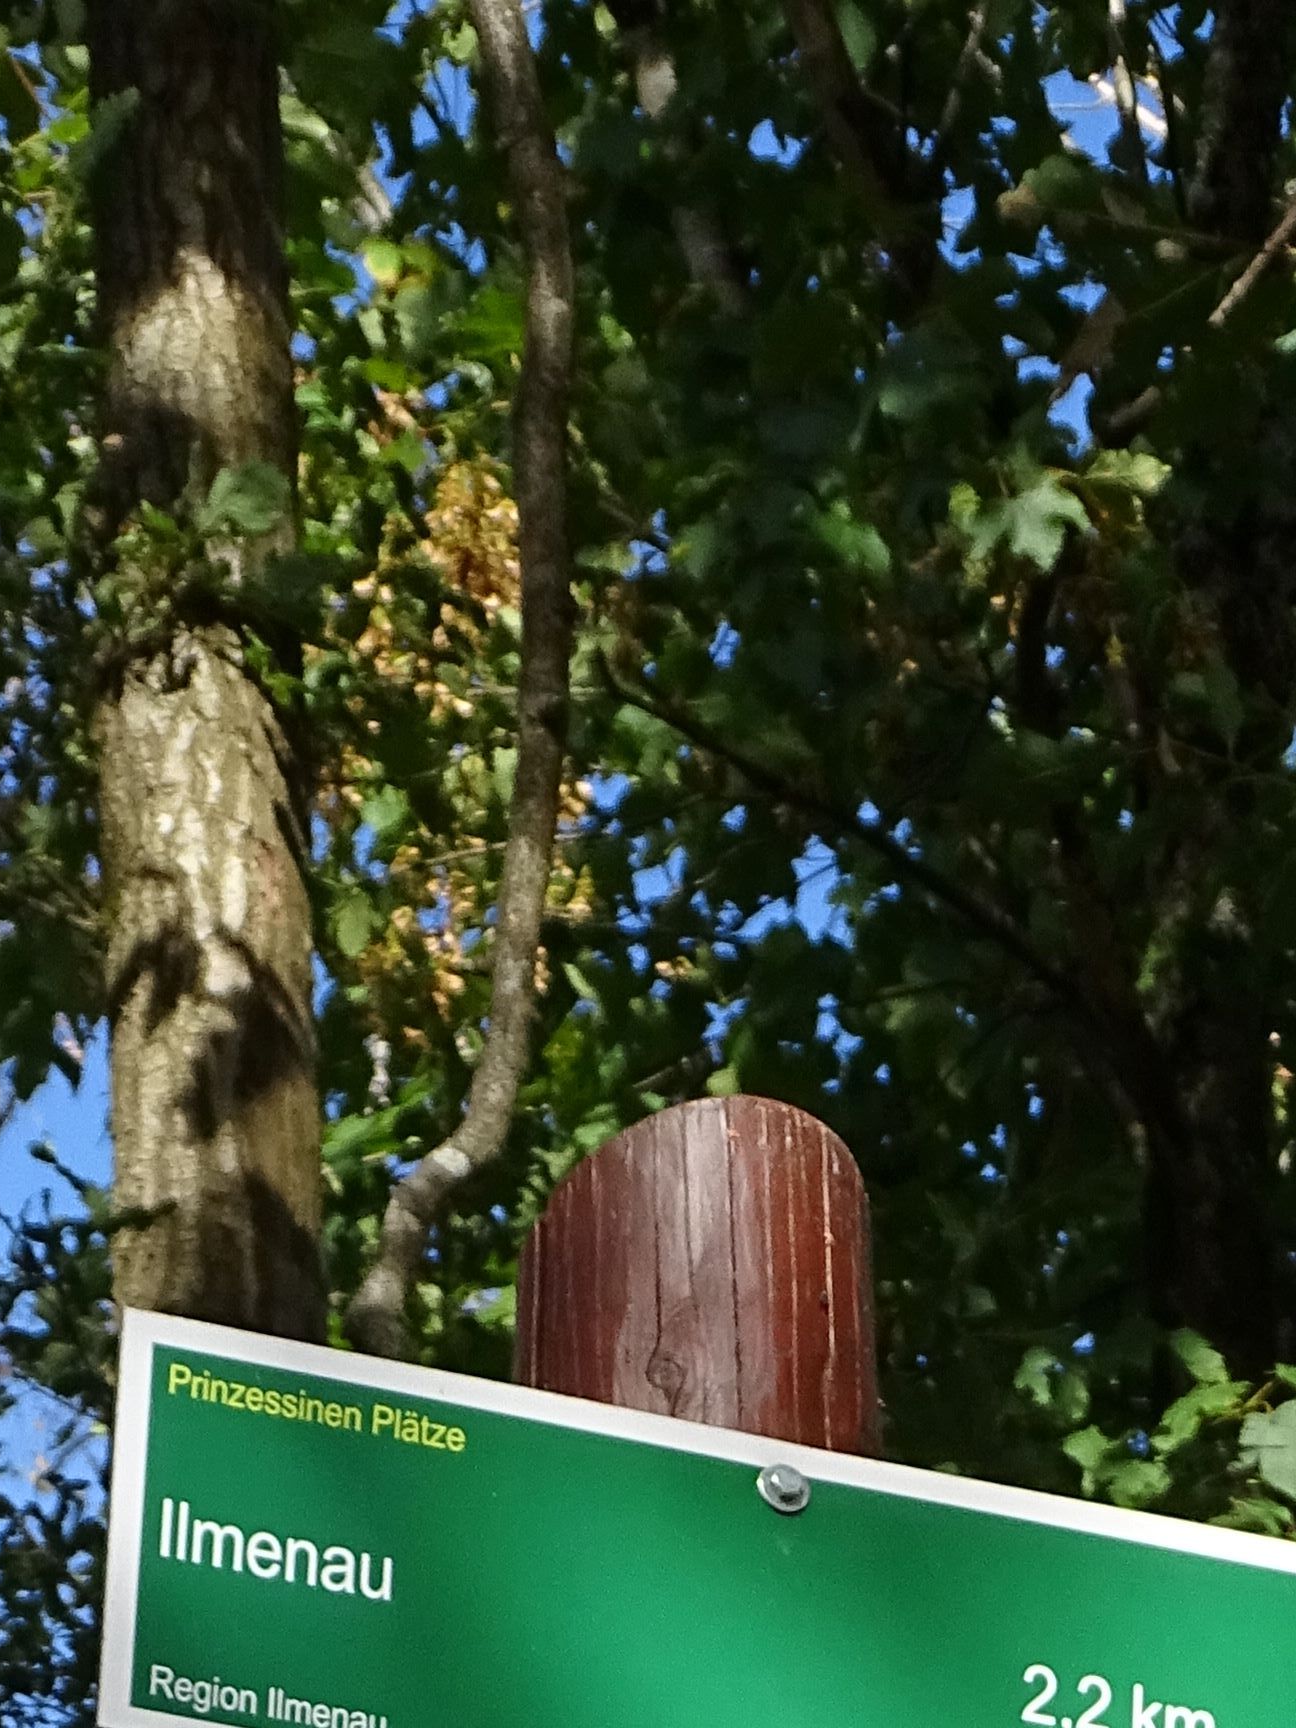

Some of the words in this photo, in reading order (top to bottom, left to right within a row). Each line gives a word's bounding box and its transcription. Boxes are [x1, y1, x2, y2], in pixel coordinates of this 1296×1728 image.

[169, 1364, 361, 1431] Prinzessinen
[372, 1404, 465, 1451] Plätze
[160, 1498, 392, 1600] Ilmenau
[150, 1665, 257, 1714] Region
